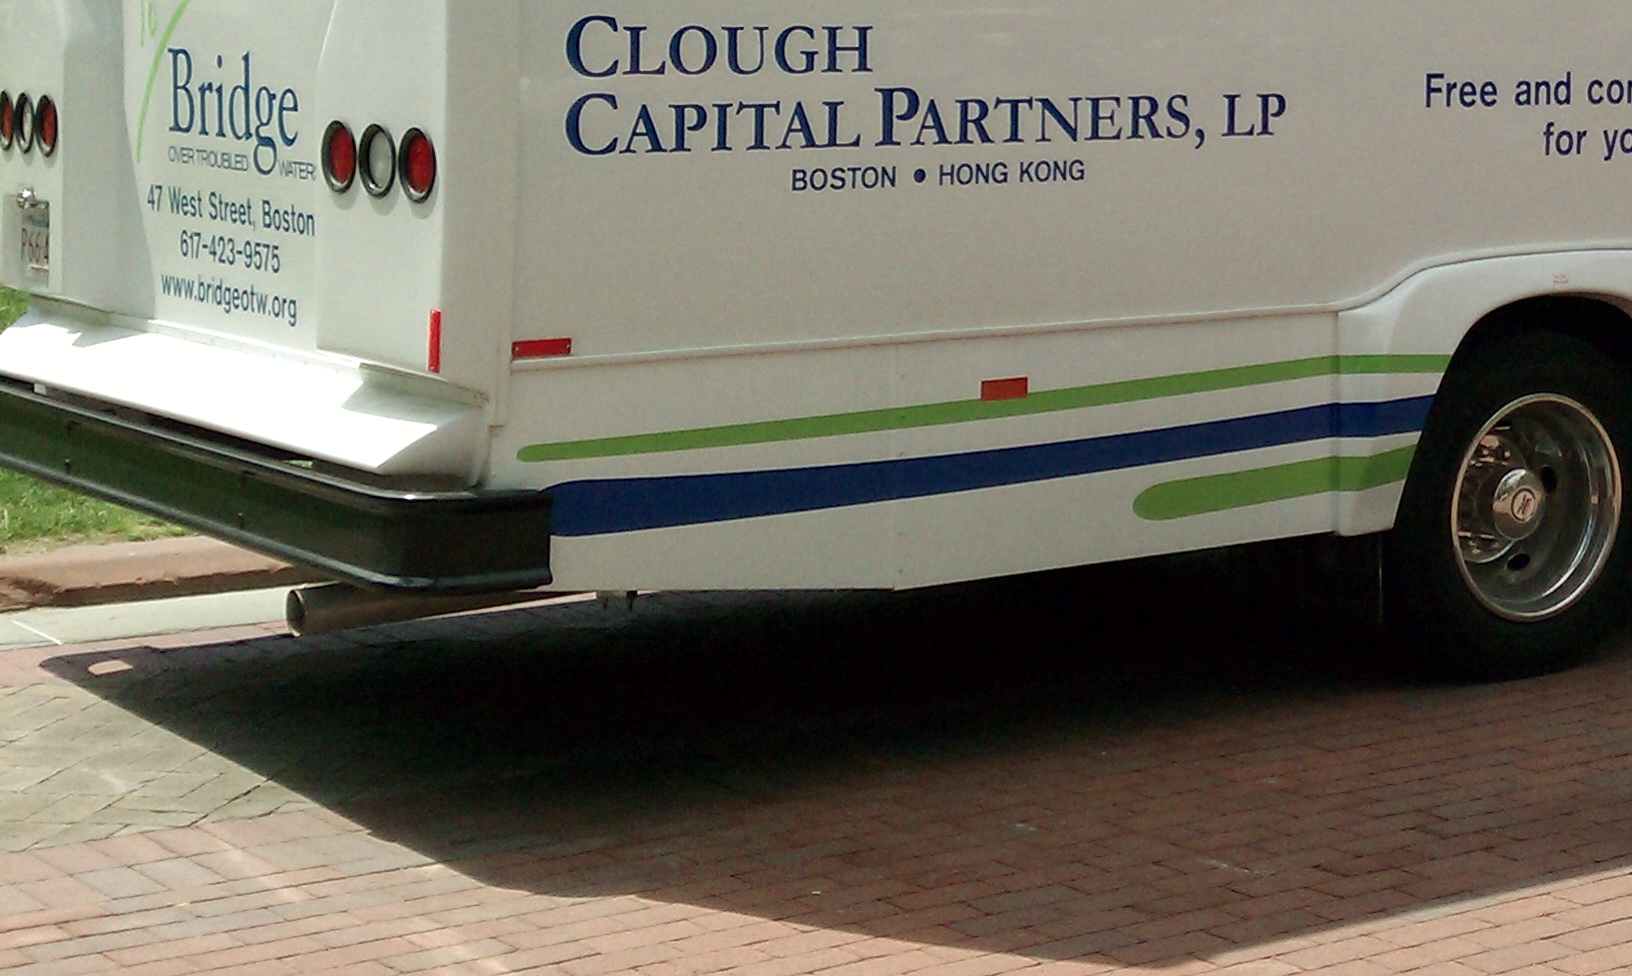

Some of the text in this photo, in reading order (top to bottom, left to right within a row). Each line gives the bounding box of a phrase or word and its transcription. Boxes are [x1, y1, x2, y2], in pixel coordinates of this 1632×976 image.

[565, 15, 874, 78] CLOUGH
[168, 47, 299, 175] Bridge
[1425, 72, 1498, 108] Free
[1514, 71, 1571, 106] and
[565, 86, 1287, 157] CAPITAL PARTNERS, LP
[1543, 122, 1587, 156] for
[168, 145, 194, 163] OVER
[195, 149, 249, 172] TROUBLED
[791, 160, 1086, 192] BOSTON HONG KONG
[147, 184, 316, 237] 47 West Street, Boston
[180, 230, 281, 274] 617-423-9575
[161, 273, 298, 327] www.bridgeotw.org
